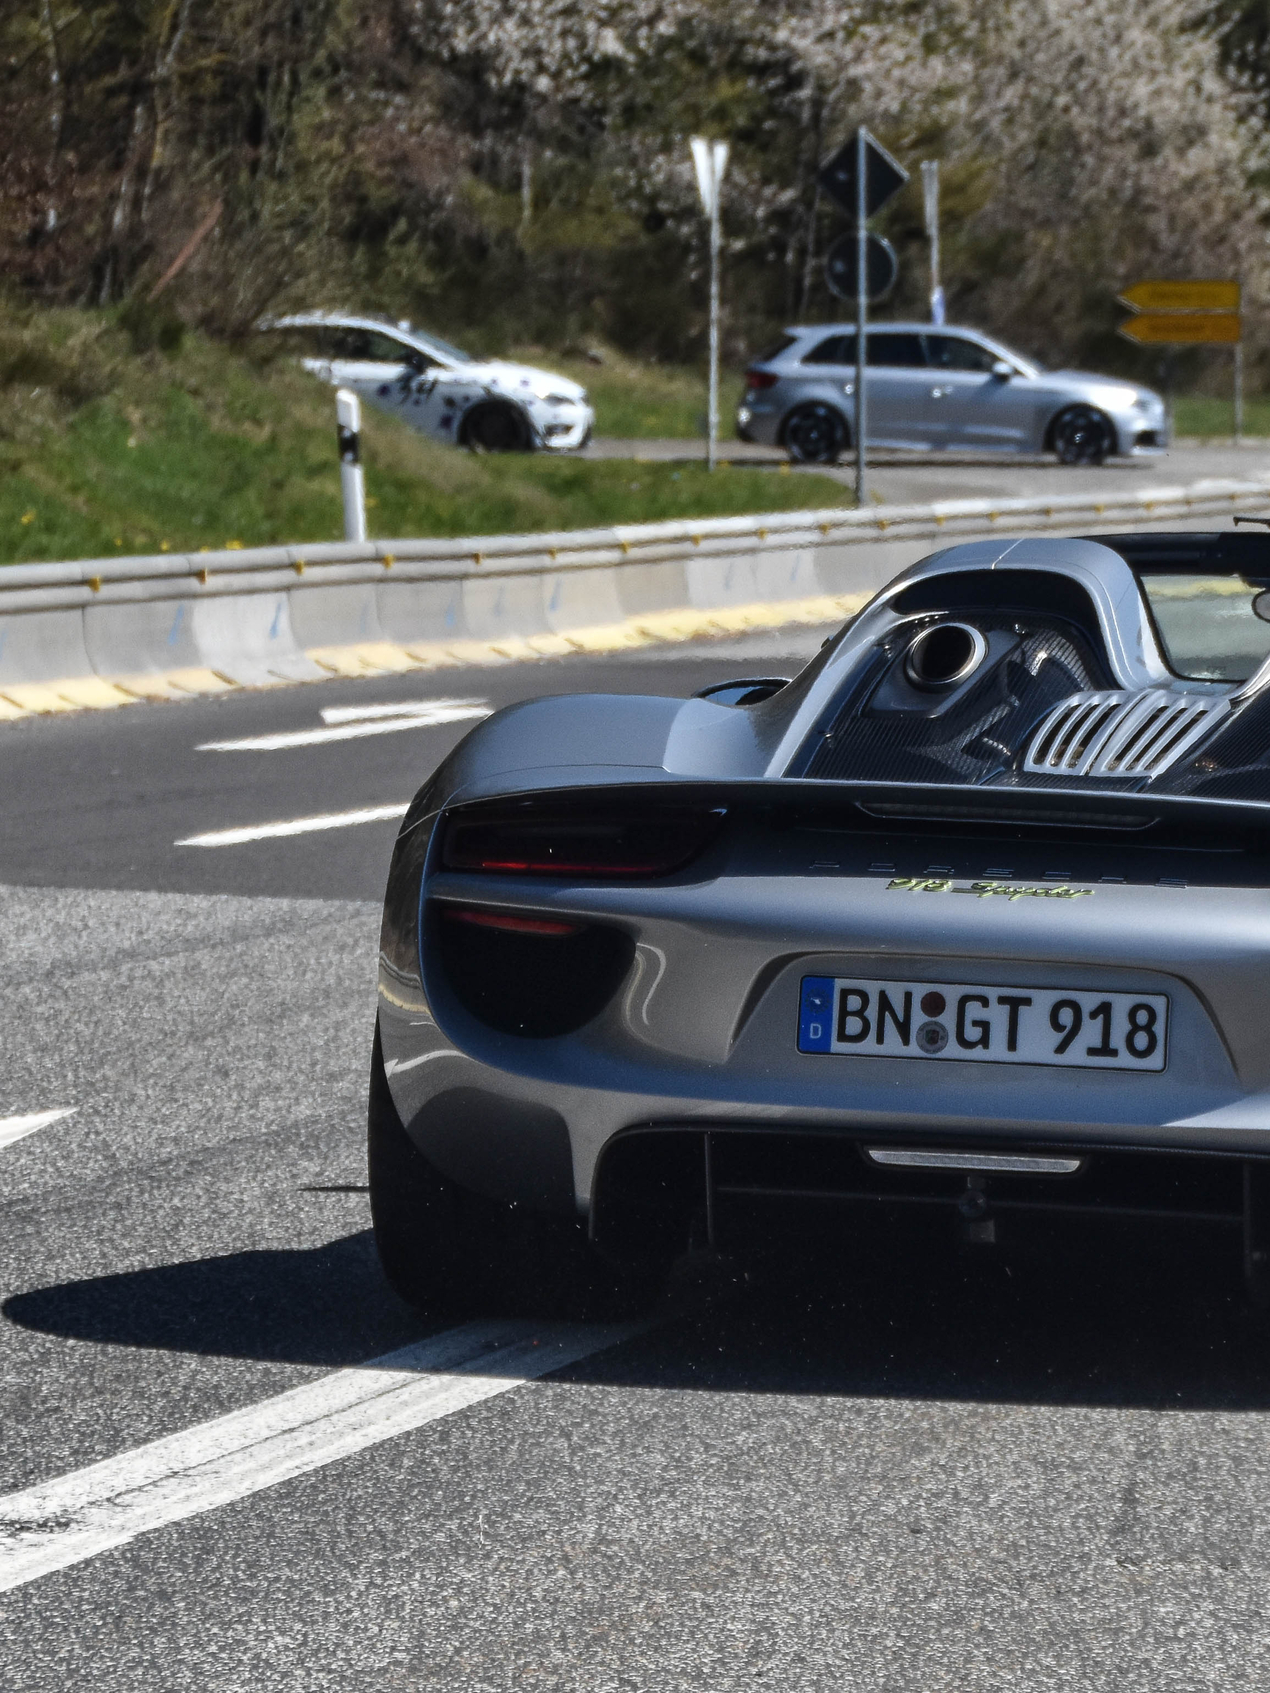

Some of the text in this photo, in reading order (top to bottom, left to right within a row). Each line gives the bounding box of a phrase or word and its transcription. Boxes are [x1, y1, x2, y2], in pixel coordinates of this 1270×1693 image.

[809, 1023, 822, 1039] D
[837, 988, 913, 1047] BN
[955, 994, 1032, 1052] GT
[1049, 999, 1158, 1059] 918
